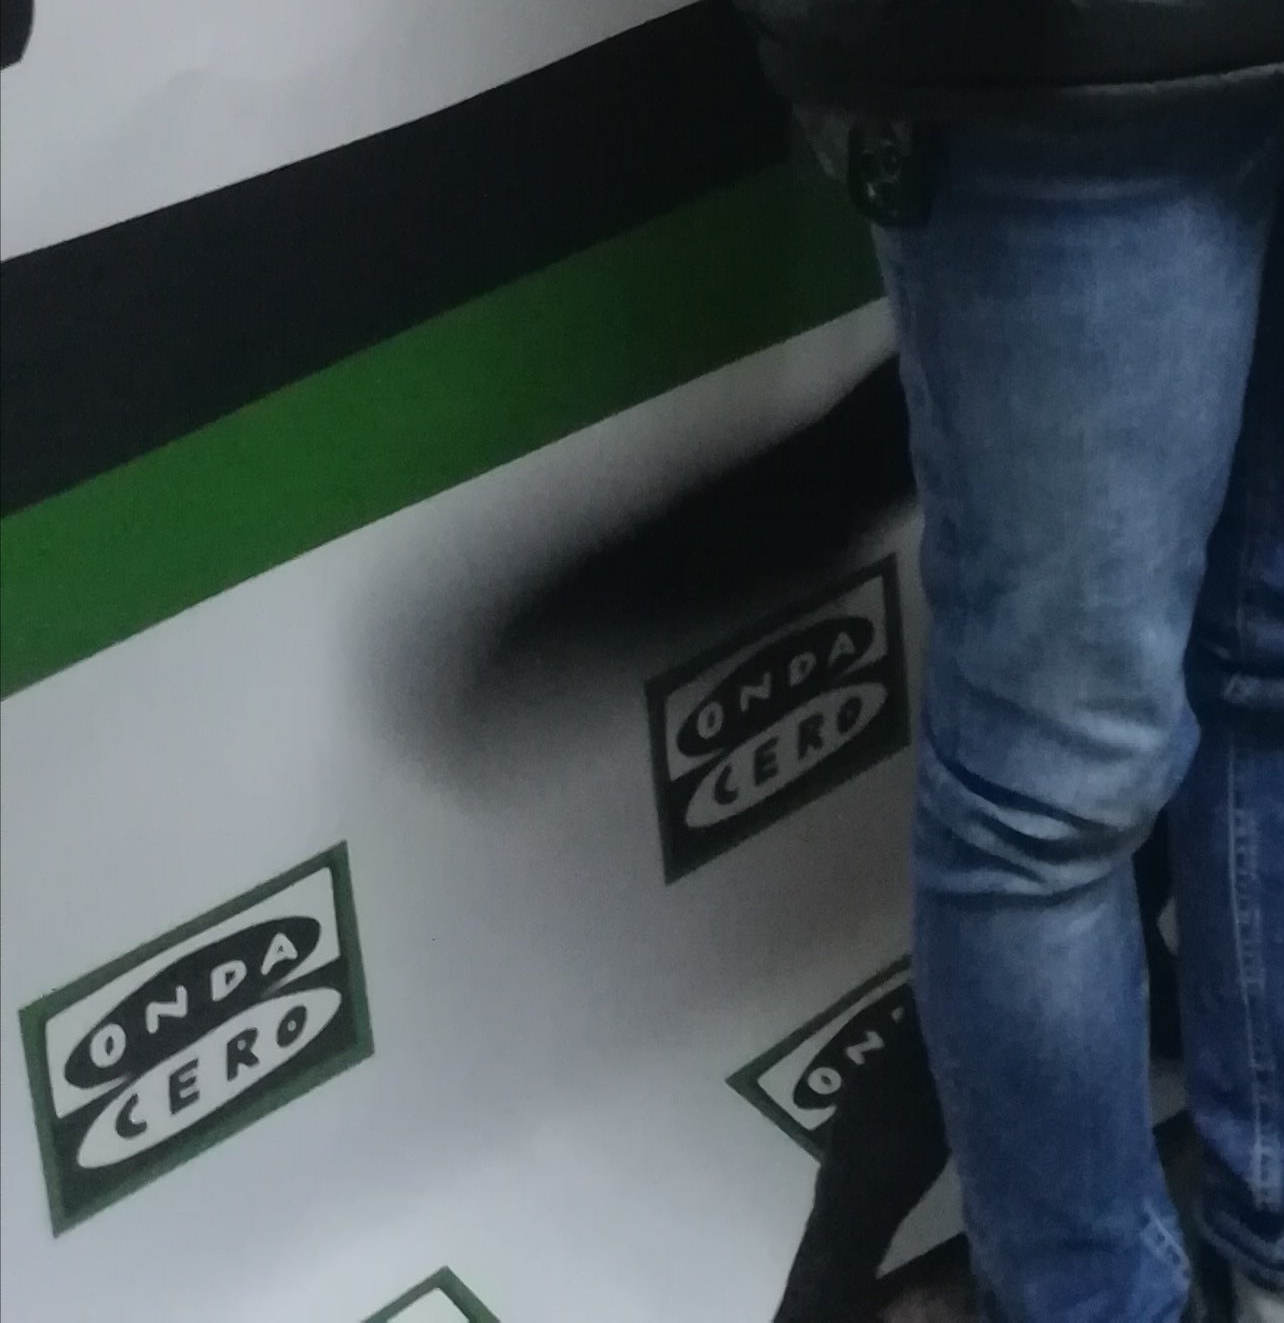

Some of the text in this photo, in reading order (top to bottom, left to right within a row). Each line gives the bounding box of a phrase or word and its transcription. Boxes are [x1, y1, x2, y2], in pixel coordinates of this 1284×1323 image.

[697, 632, 855, 739] ONDA
[713, 697, 863, 805] CERO
[90, 931, 298, 1068] ONDA
[115, 1005, 308, 1139] CERO
